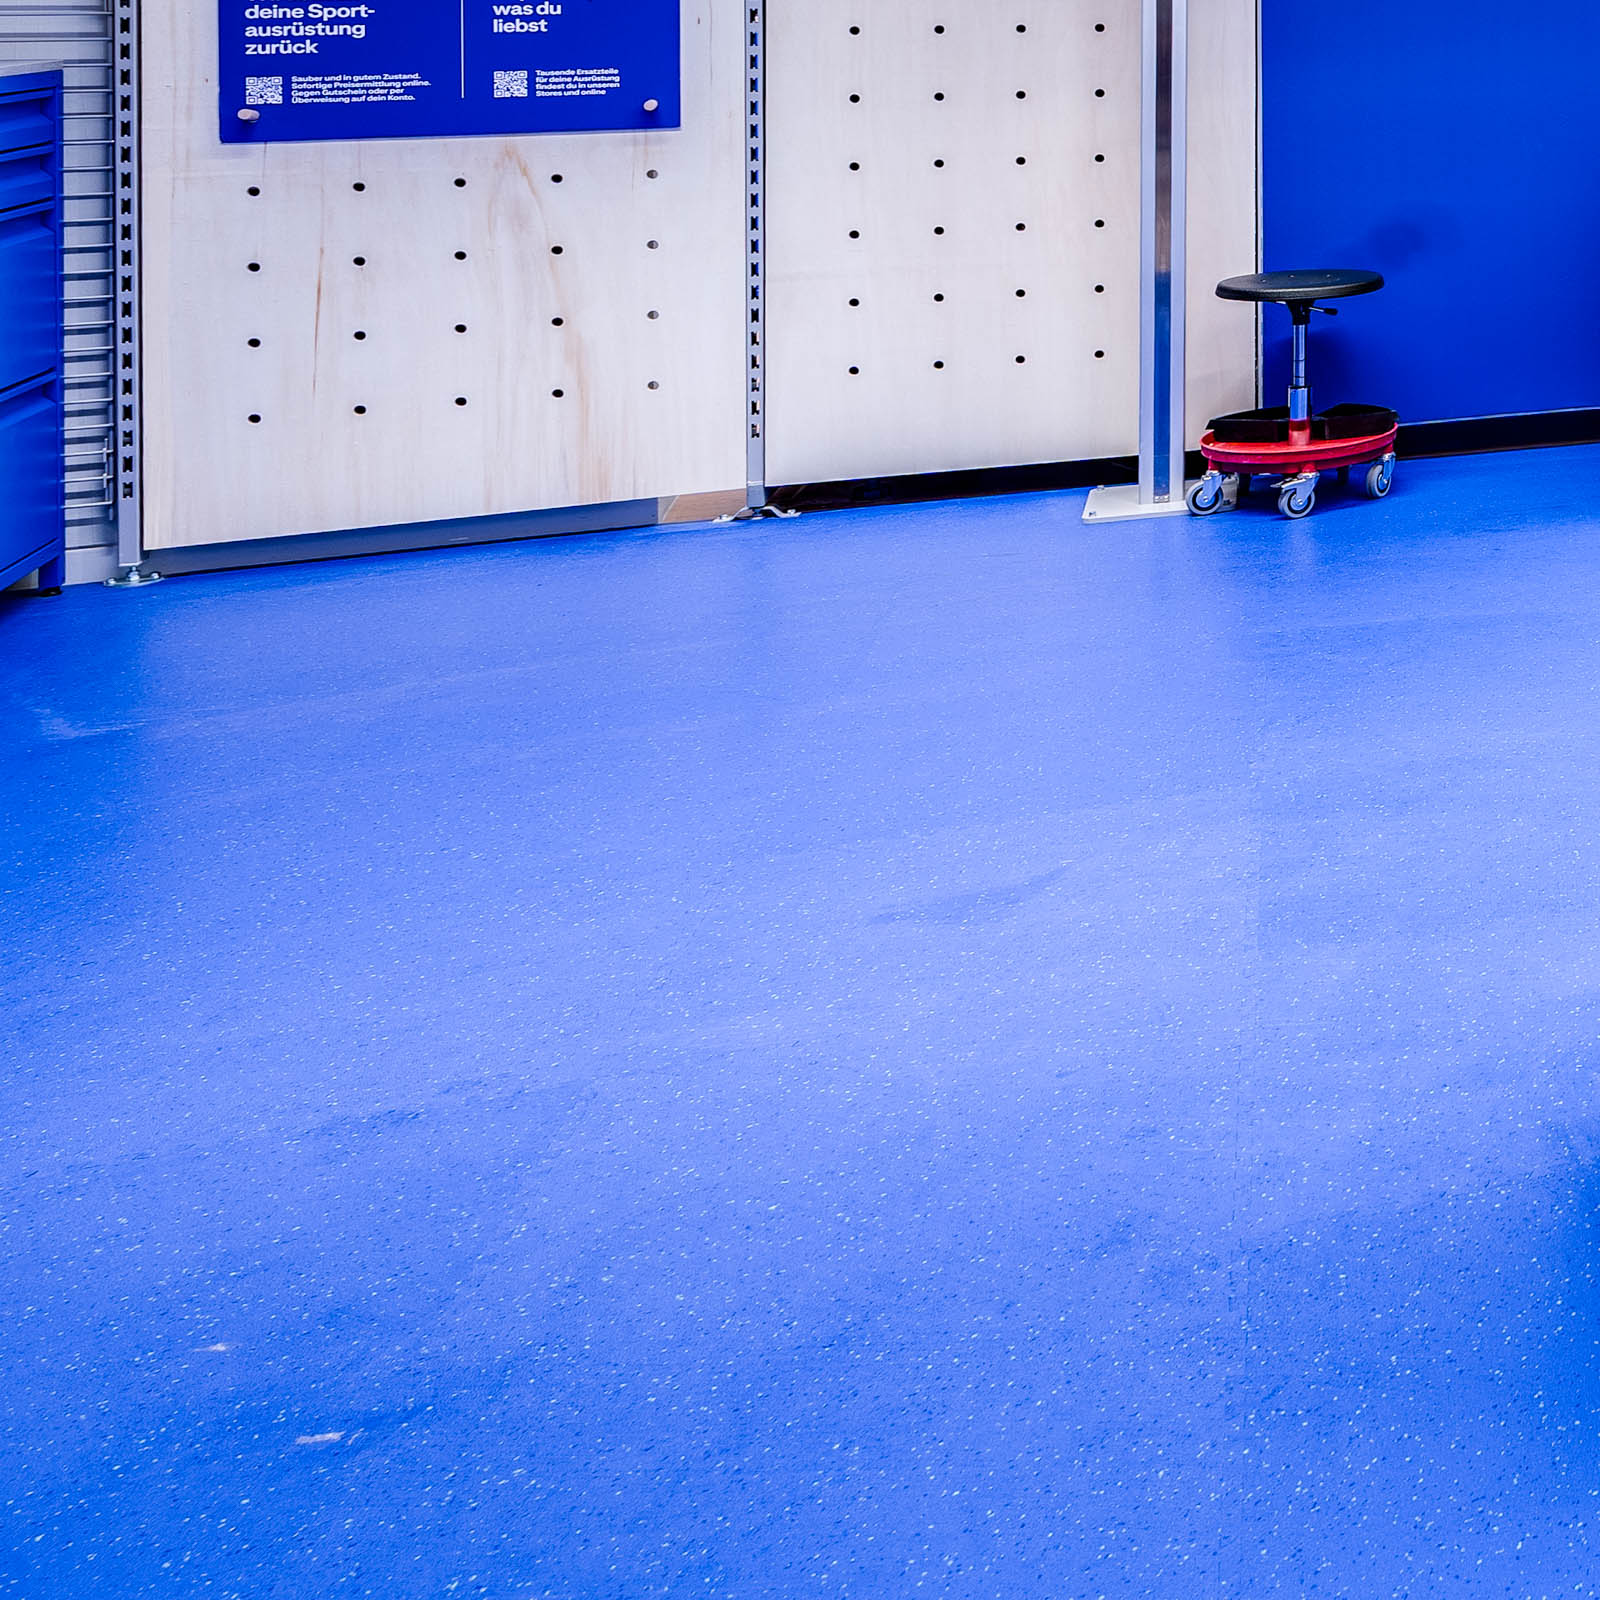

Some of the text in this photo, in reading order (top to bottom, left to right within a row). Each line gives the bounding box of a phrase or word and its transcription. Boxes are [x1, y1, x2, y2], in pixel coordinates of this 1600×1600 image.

[244, 4, 376, 22] deine Sport-
[493, 1, 562, 16] was du
[245, 22, 366, 39] ausrüstung
[493, 18, 548, 33] liebst
[245, 39, 319, 55] zurück
